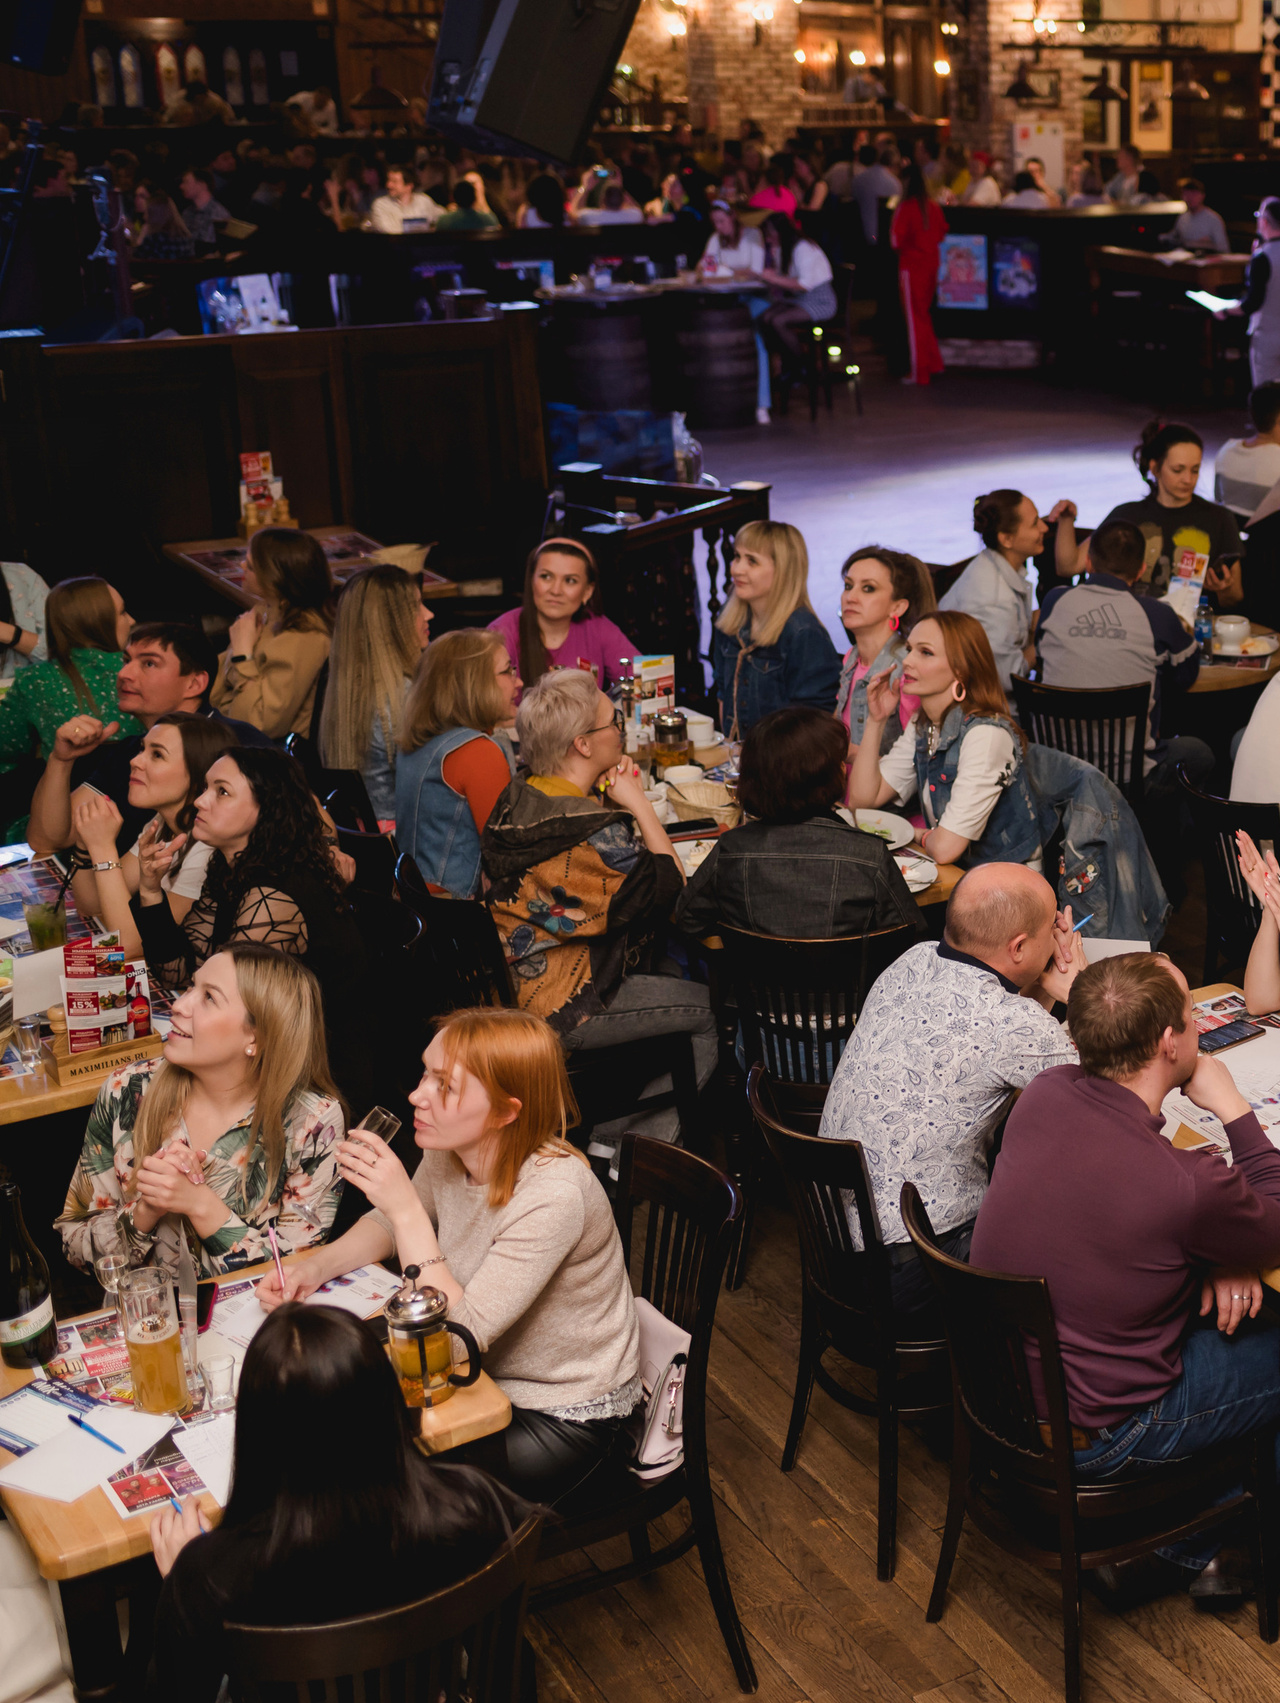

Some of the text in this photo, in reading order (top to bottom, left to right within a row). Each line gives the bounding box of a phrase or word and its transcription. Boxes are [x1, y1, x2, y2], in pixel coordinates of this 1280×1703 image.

[1068, 623, 1127, 640] adidas
[126, 967, 145, 979] ONIC
[71, 1001, 94, 1009] 15%
[69, 1051, 149, 1077] MAXIMILIANS.RU
